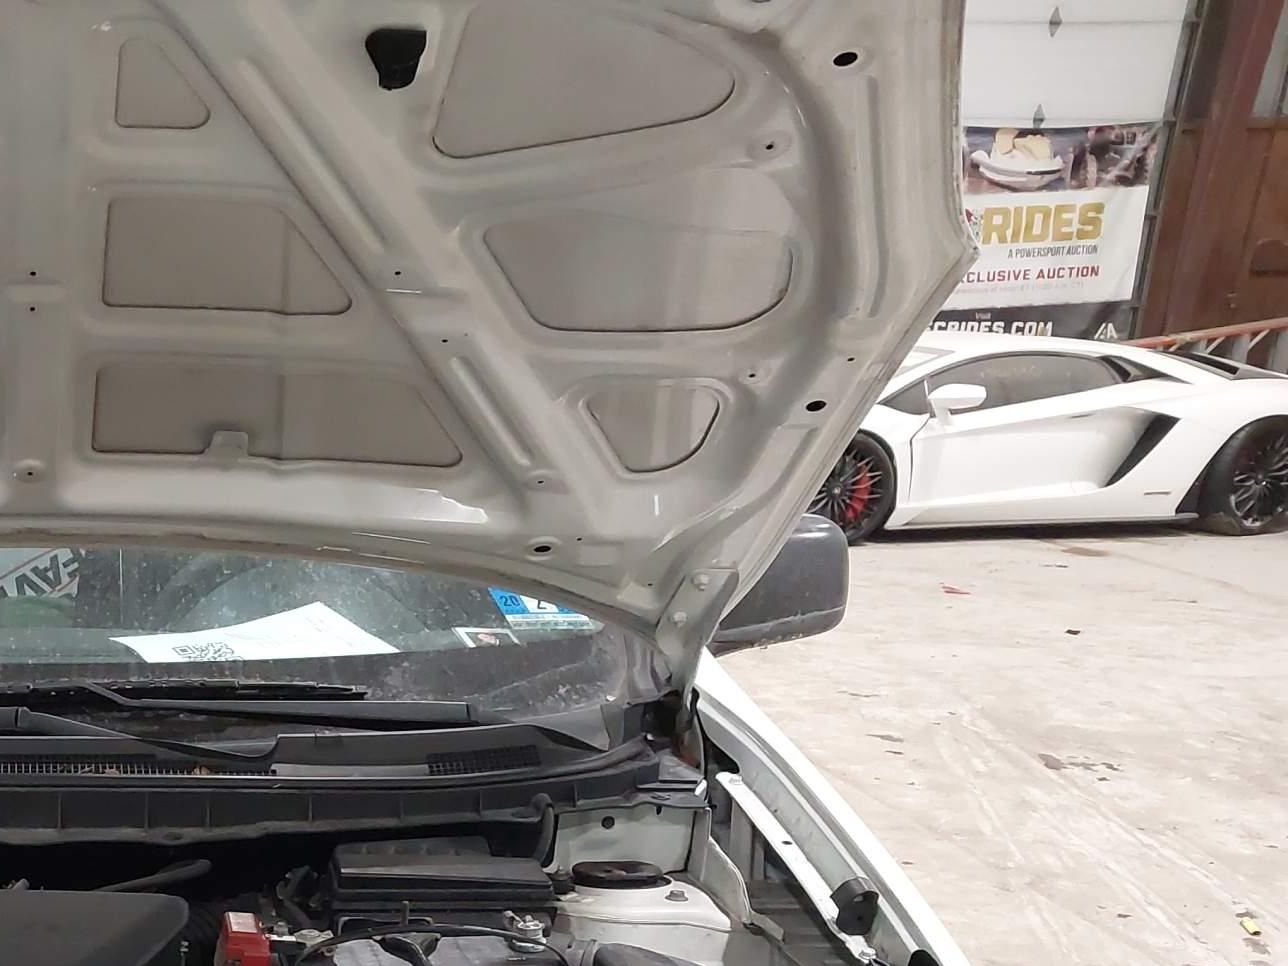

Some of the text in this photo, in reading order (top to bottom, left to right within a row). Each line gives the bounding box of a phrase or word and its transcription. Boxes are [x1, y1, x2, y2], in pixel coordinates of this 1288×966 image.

[981, 202, 1105, 245] RIDES
[1008, 244, 1098, 259] A POWERSPORT AUCTION
[1036, 264, 1099, 279] AUCTION
[500, 595, 521, 607] 20
